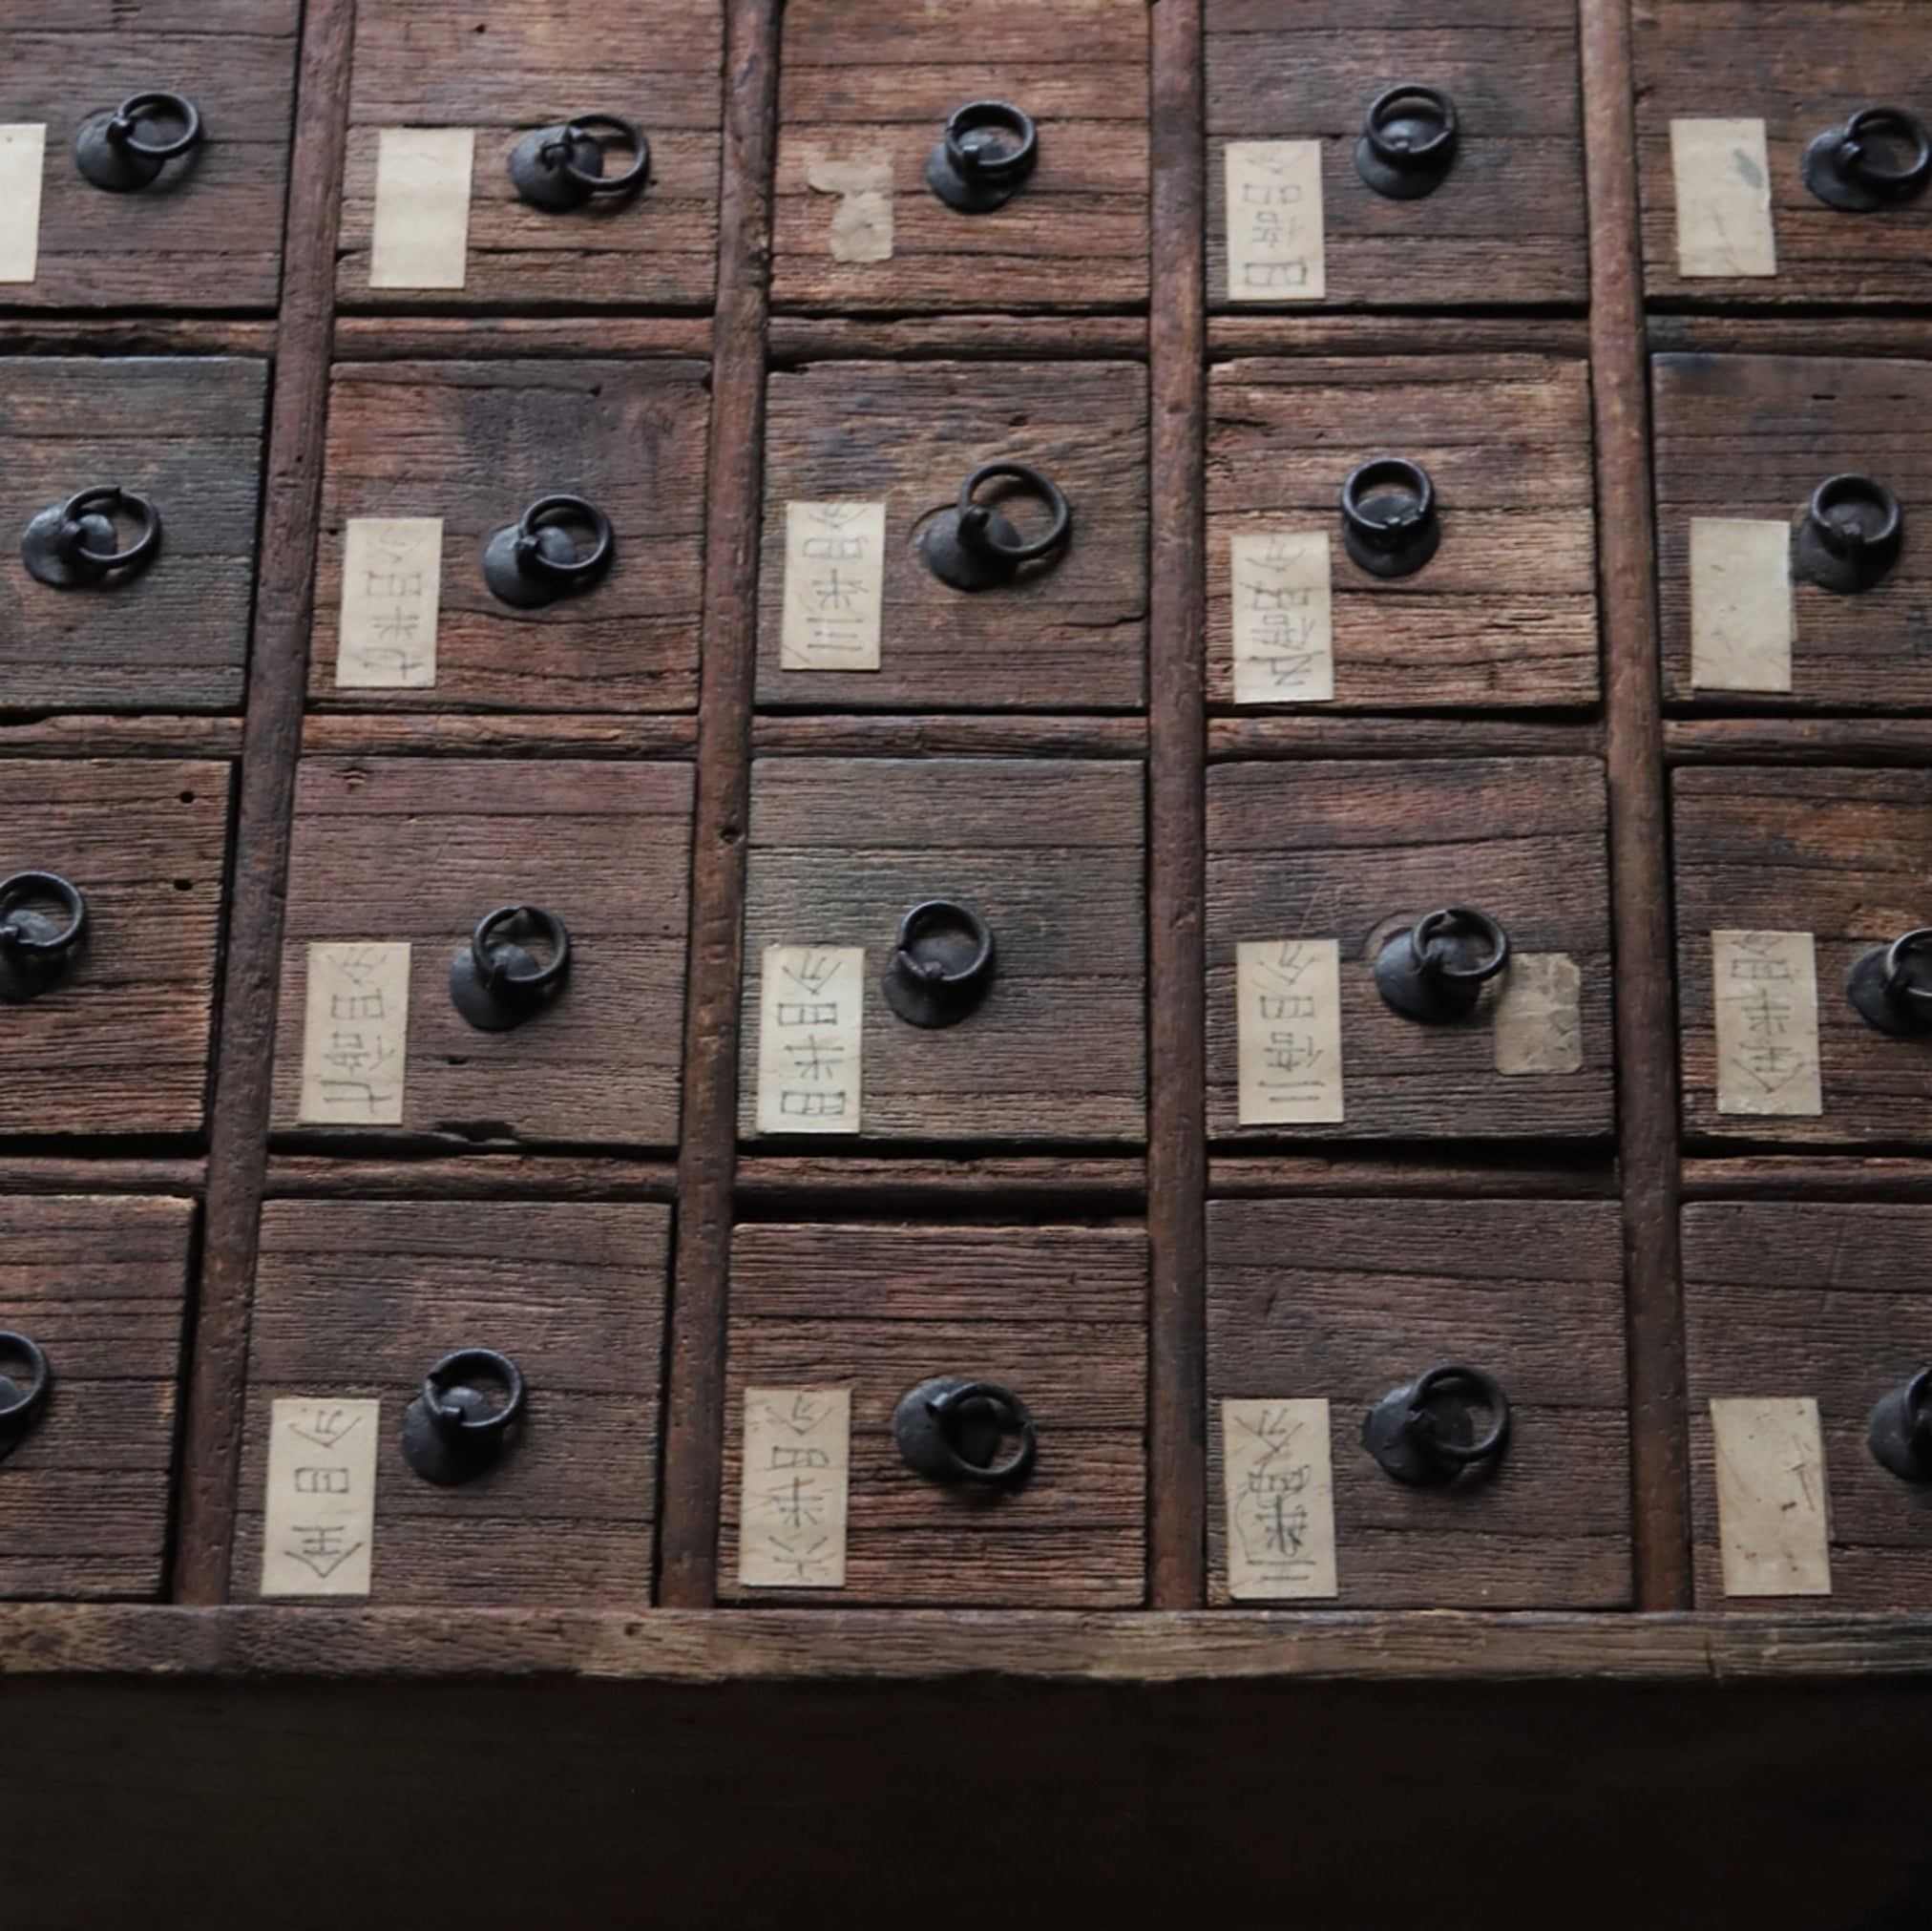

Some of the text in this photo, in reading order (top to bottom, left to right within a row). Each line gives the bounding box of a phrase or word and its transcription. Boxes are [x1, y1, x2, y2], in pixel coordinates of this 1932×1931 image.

[320, 945, 396, 1114] 七倍四分
[777, 951, 847, 1116] 四半四分
[1256, 940, 1326, 1103] 二倍四分
[284, 1408, 365, 1580] 全四分
